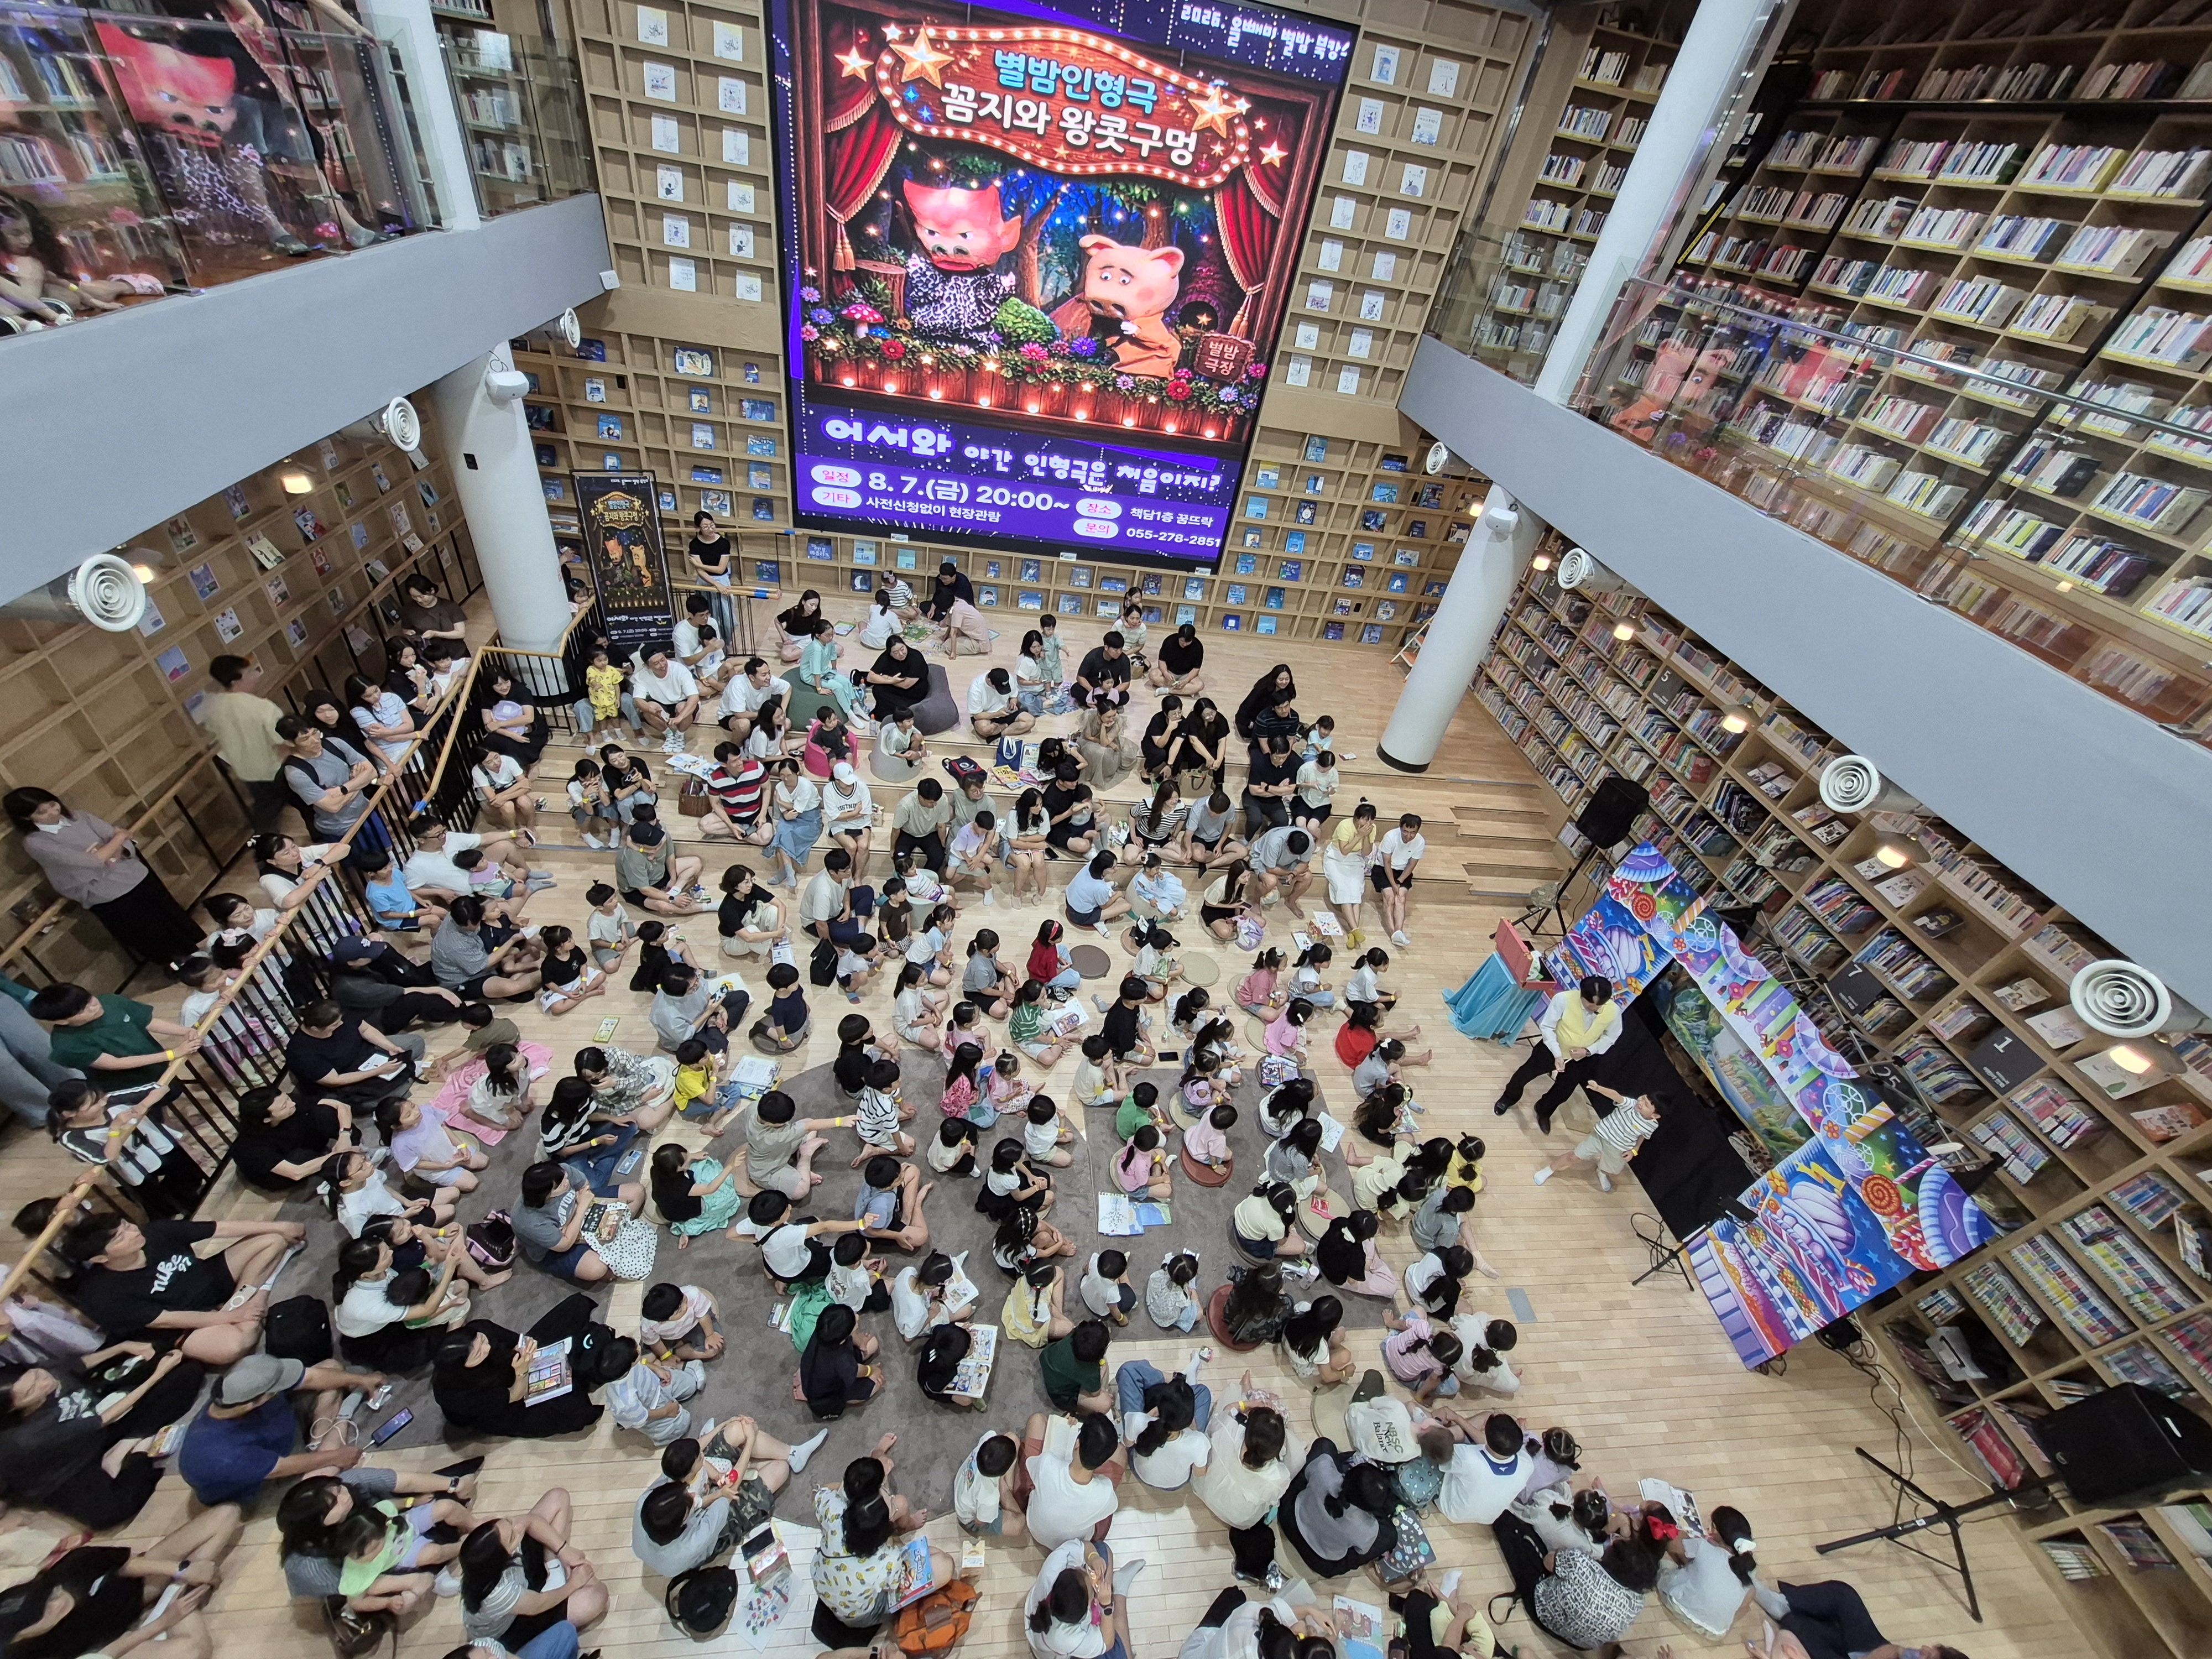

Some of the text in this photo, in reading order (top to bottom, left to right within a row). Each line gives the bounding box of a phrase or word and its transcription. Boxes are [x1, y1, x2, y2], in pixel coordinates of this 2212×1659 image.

[1227, 16, 1277, 48] 올빼미
[1281, 28, 1314, 57] 별밤
[995, 49, 1158, 114] 별밤인형극
[941, 82, 1197, 165] 꼼지와 왕콧구멍
[1209, 341, 1239, 360] 별밤
[1204, 358, 1235, 375] 극장
[825, 419, 1221, 493] 어서와 야간 인형극은 처음이지?
[822, 469, 1070, 510] 일정 8. 7.(금) 20:00~
[822, 491, 1001, 523] 기타 사전신청없이 현장관람
[1086, 503, 1214, 528] 장소 책담1층 꿈뜨락
[1084, 522, 1221, 547] 문의 055-278-2851
[1549, 576, 1556, 586] 3
[1533, 648, 1539, 657] 4
[1661, 670, 1671, 682] 5
[1848, 964, 1863, 977] 7
[1993, 1036, 2013, 1053] 1
[1876, 1066, 1901, 1088] 25
[178, 1256, 192, 1272] 97
[1385, 1421, 1404, 1454] NBSC
